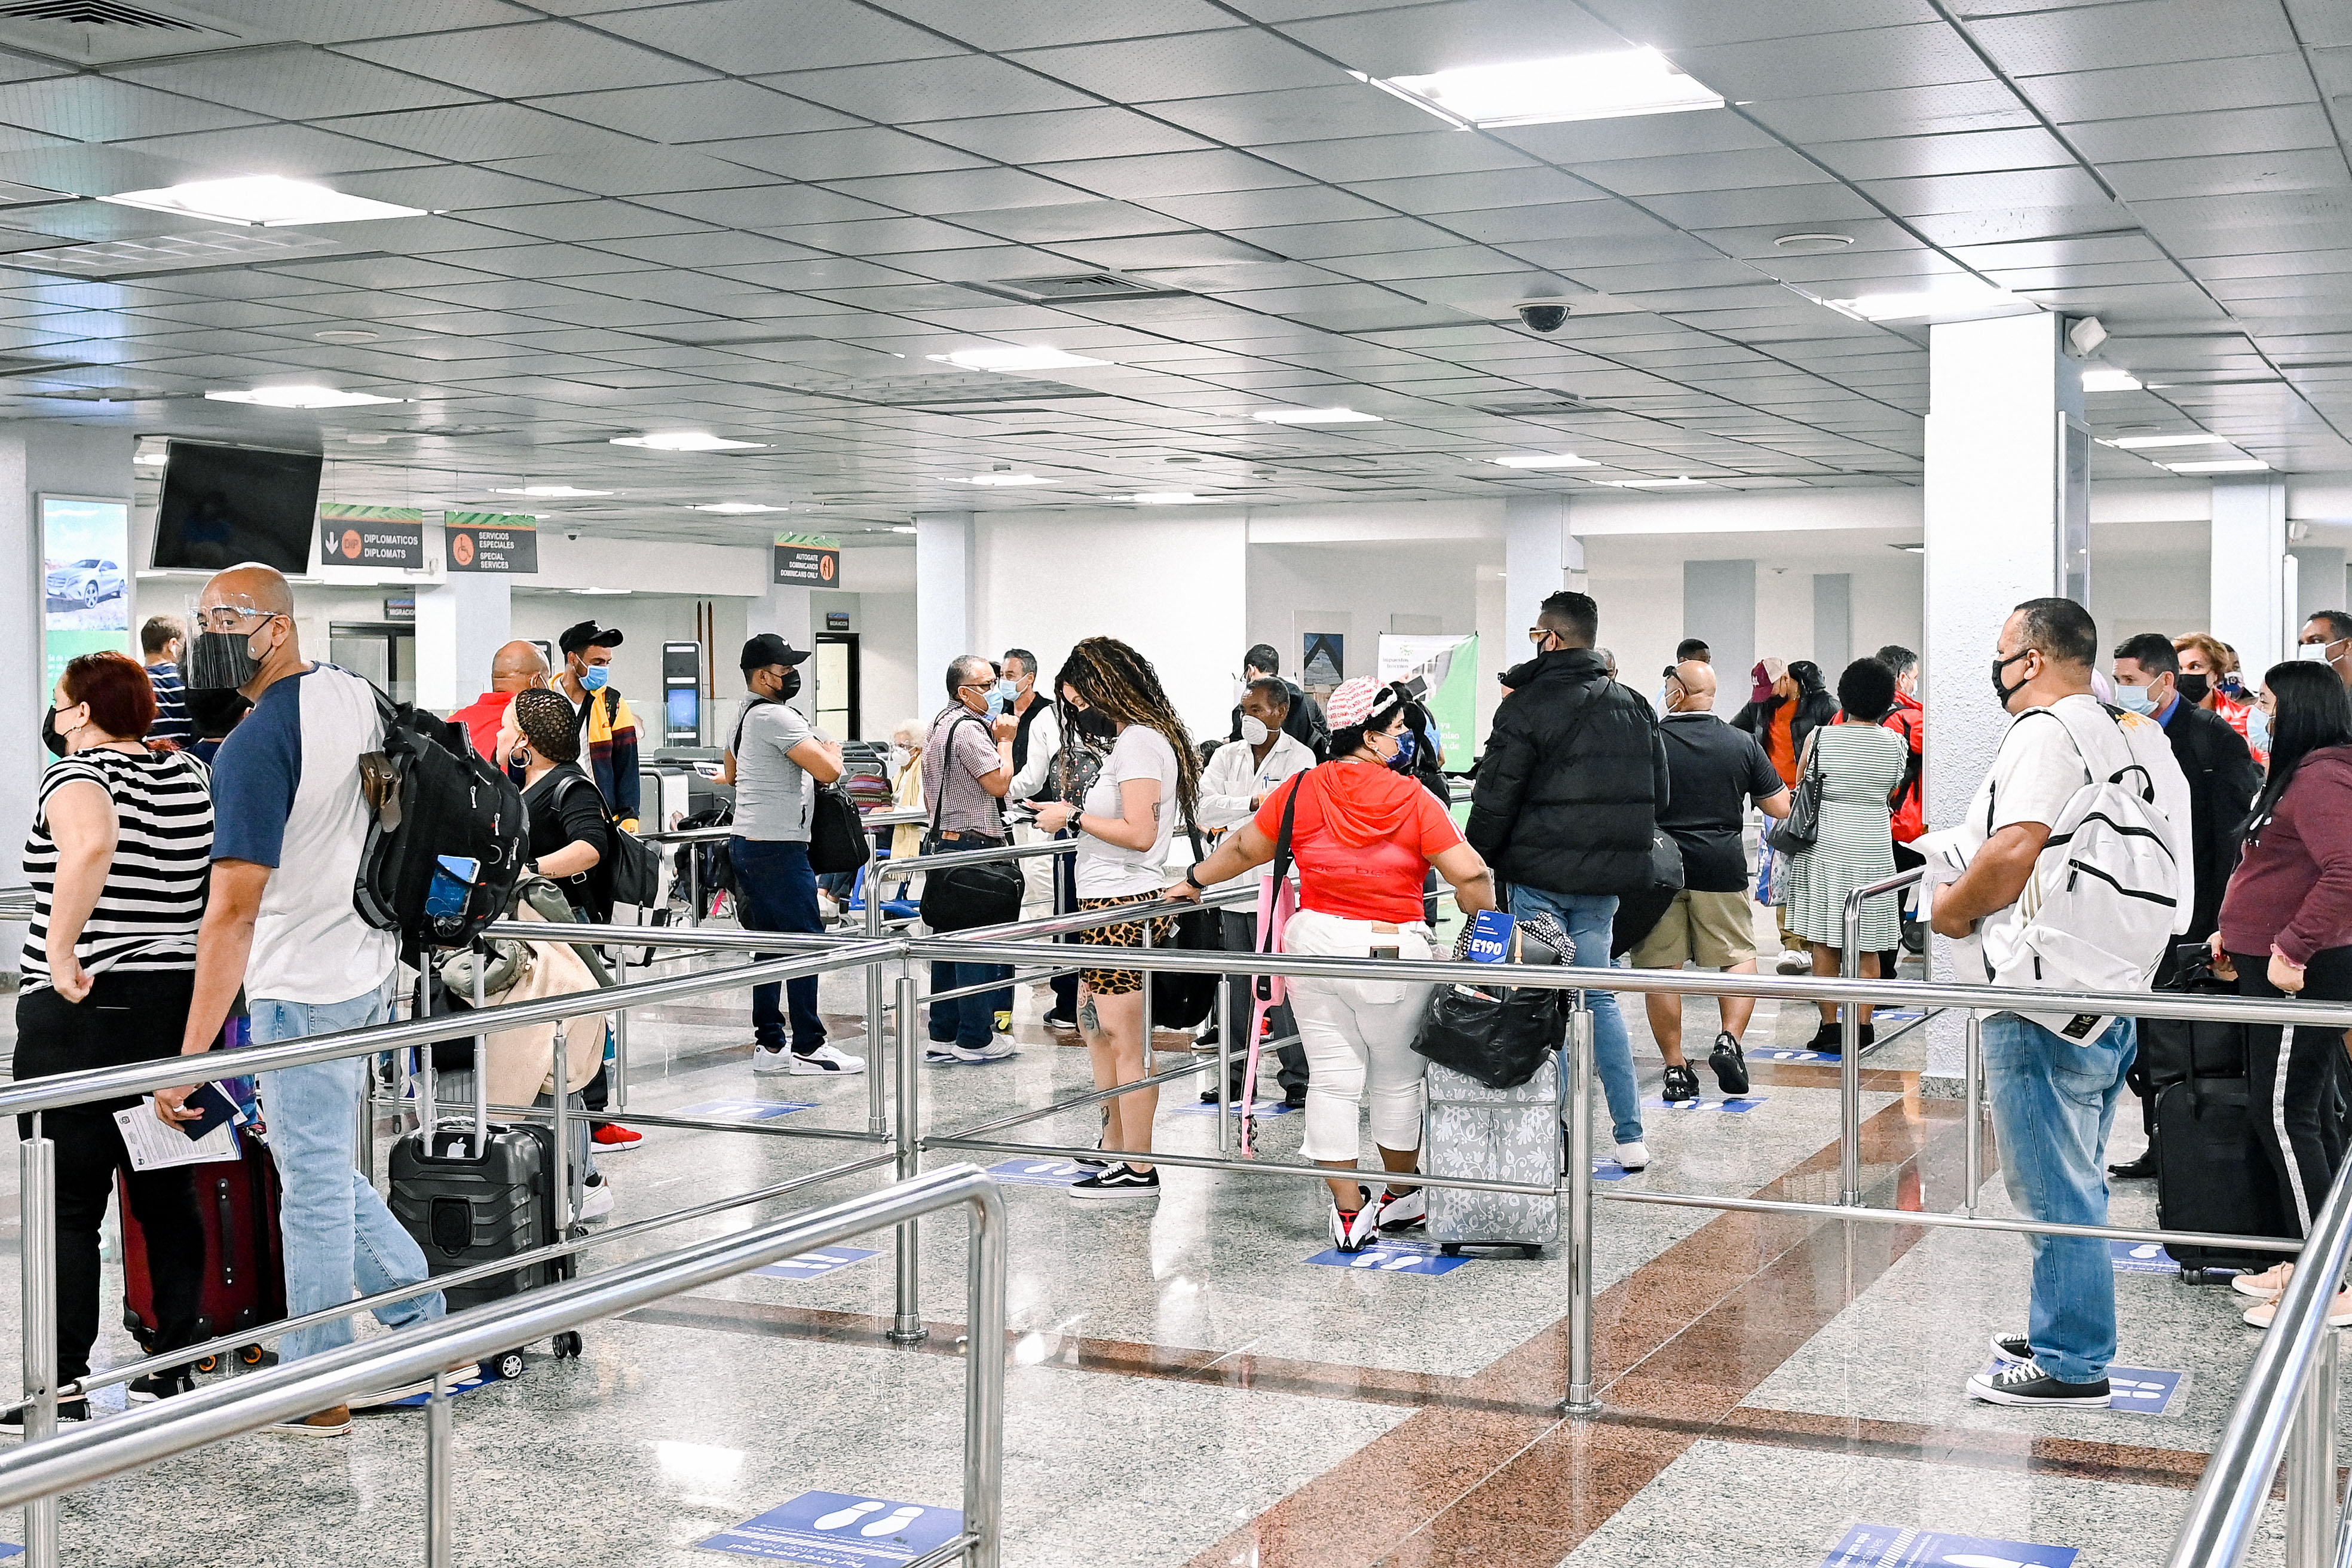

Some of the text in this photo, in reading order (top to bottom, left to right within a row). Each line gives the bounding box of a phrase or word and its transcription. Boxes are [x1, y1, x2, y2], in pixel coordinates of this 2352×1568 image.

[364, 534, 418, 546] DIPLOMATICOS
[479, 531, 509, 540] SERVICIOS
[344, 539, 359, 549] DIP
[479, 540, 514, 549] ESPECIALES
[364, 548, 406, 559] DIPLOMATS
[480, 552, 504, 561] SPECIAL
[480, 561, 509, 569] SERVICES
[1471, 939, 1503, 956] E190
[751, 1541, 782, 1549] here
[798, 1554, 838, 1564] favor
